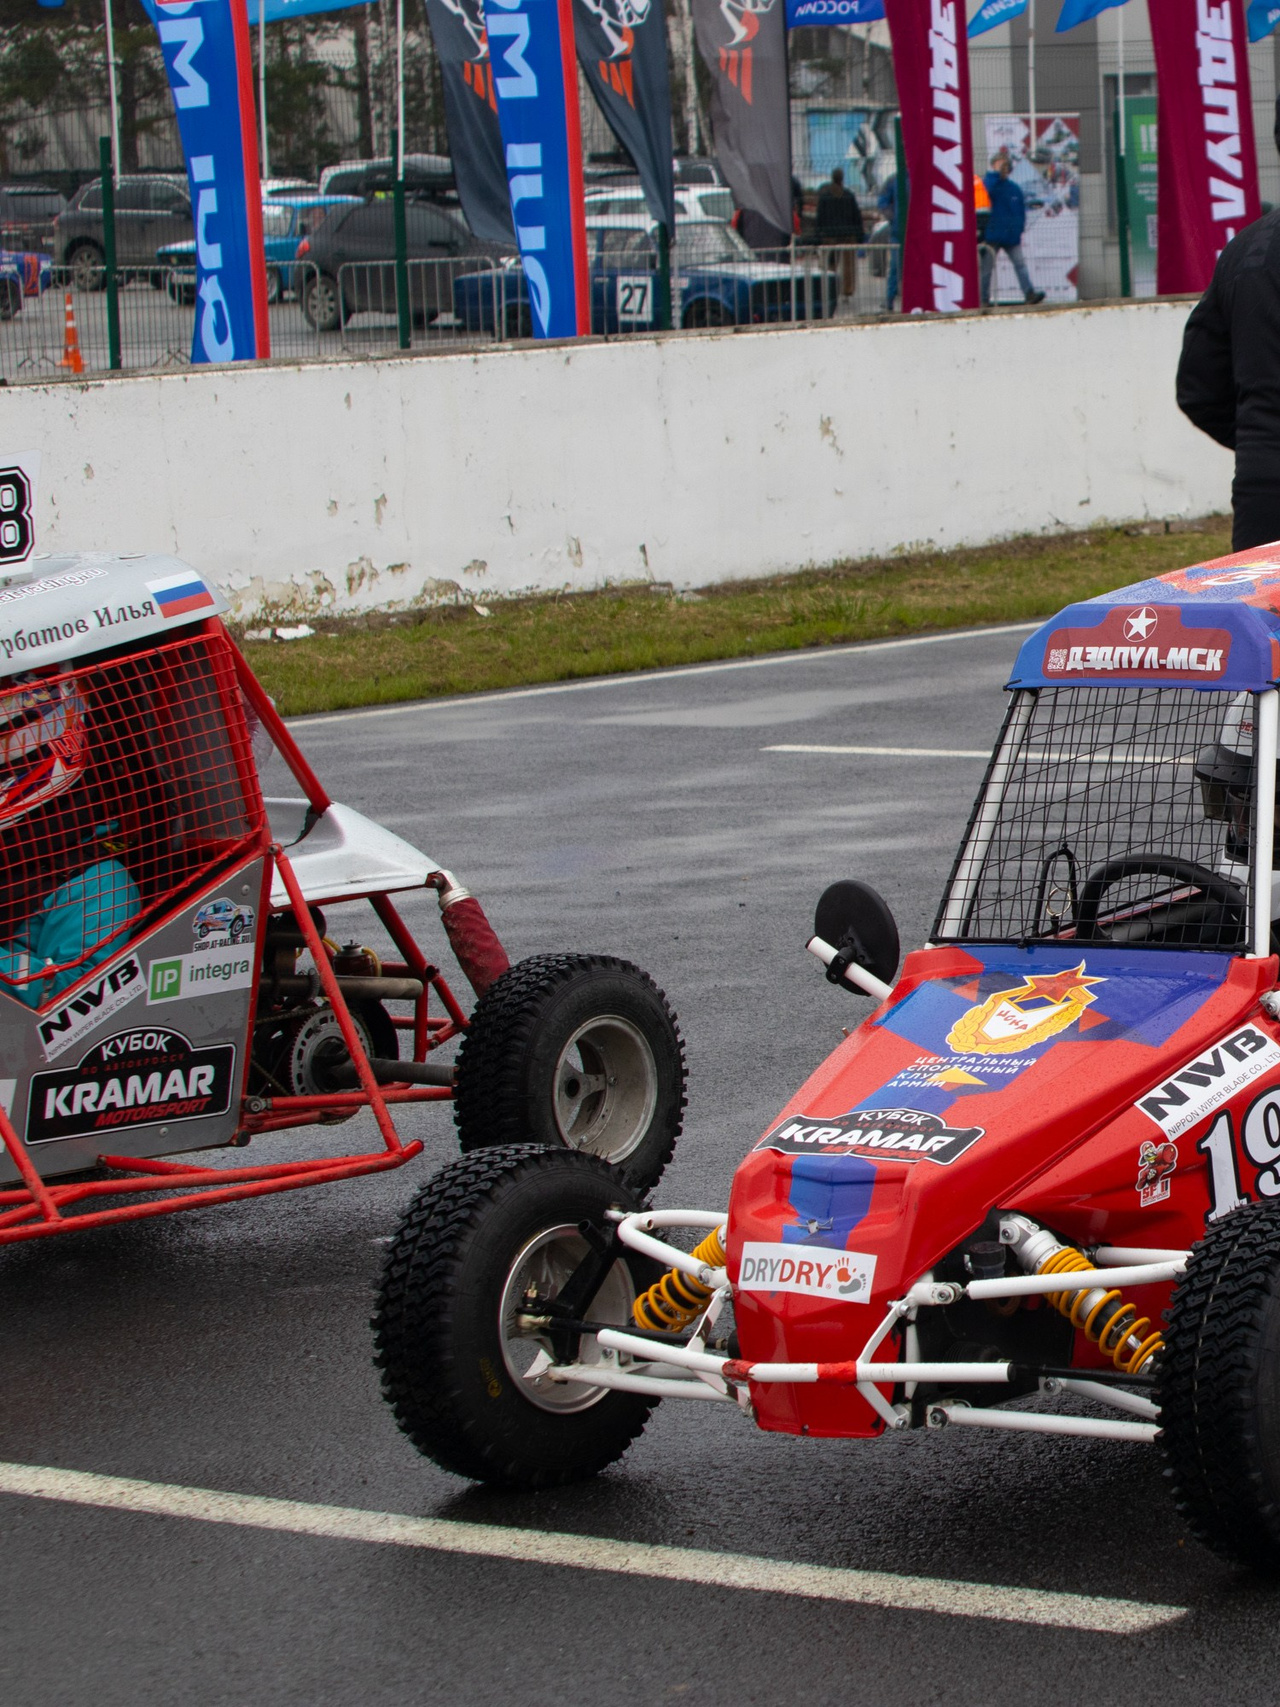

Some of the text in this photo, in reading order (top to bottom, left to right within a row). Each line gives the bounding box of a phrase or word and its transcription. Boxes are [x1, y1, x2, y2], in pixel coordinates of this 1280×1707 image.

[620, 282, 648, 315] 27
[0, 600, 157, 659] рбатов Илья
[1066, 646, 1224, 671] ДЭДПУЛ-МСК
[154, 960, 250, 994] IP integra
[39, 957, 140, 1045] NWB
[73, 1018, 94, 1041] WIPER
[93, 1004, 116, 1026] BLADE
[101, 1032, 172, 1062] КУБОК
[914, 1056, 1038, 1067] ЦЕНТРАЛЬНЫЙ
[886, 1080, 947, 1088] АРМИИ
[897, 1072, 940, 1080] КЛУБ
[906, 1064, 1020, 1075] СПОРТИВНЫЙ
[1139, 1028, 1268, 1122] NWB
[44, 1064, 215, 1120] KRAMAR
[1167, 1111, 1200, 1137] NIPPON
[1199, 1090, 1225, 1113] WIPER
[1224, 1072, 1251, 1094] BLADE
[94, 1097, 212, 1128] MOTORSPORT
[858, 1111, 931, 1126] КУБОК
[778, 1123, 956, 1152] KRAMAR
